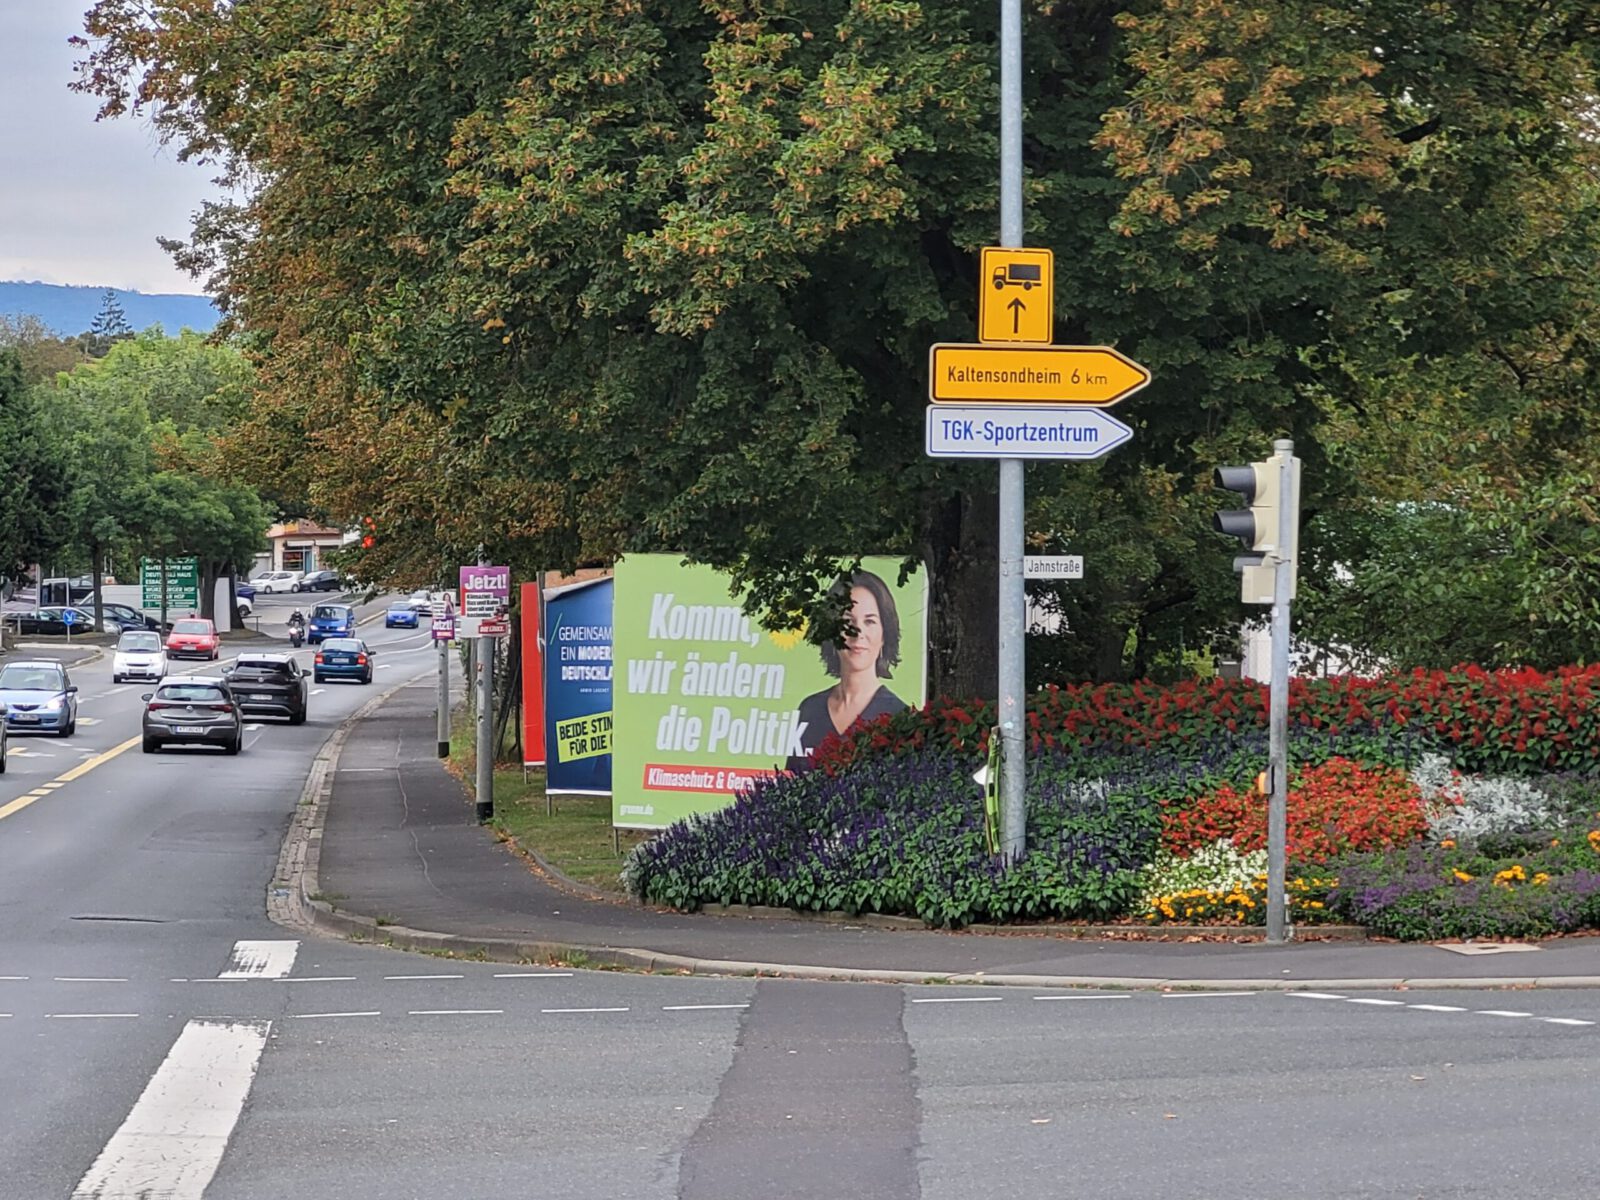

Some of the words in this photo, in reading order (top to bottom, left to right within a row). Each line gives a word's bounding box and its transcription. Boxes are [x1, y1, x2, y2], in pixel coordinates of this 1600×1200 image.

[947, 365, 1062, 384] Kaltensondheim
[1070, 368, 1080, 384] 6
[1085, 371, 1108, 386] km
[941, 419, 1099, 447] TGK-Sportzentrum
[1028, 559, 1080, 573] Jahnstraße
[464, 573, 507, 590] Jetzt!
[559, 626, 612, 641] GEMEINSAM
[561, 646, 576, 661] EIN
[628, 651, 677, 695] wir
[681, 651, 785, 699] ändern
[559, 721, 589, 741] BEIDE
[656, 704, 702, 752] die
[708, 706, 814, 757] Politik.
[569, 738, 588, 756] FÜR
[590, 734, 608, 752] DIE
[648, 767, 714, 789] Klimaschutz
[715, 771, 724, 789] &
